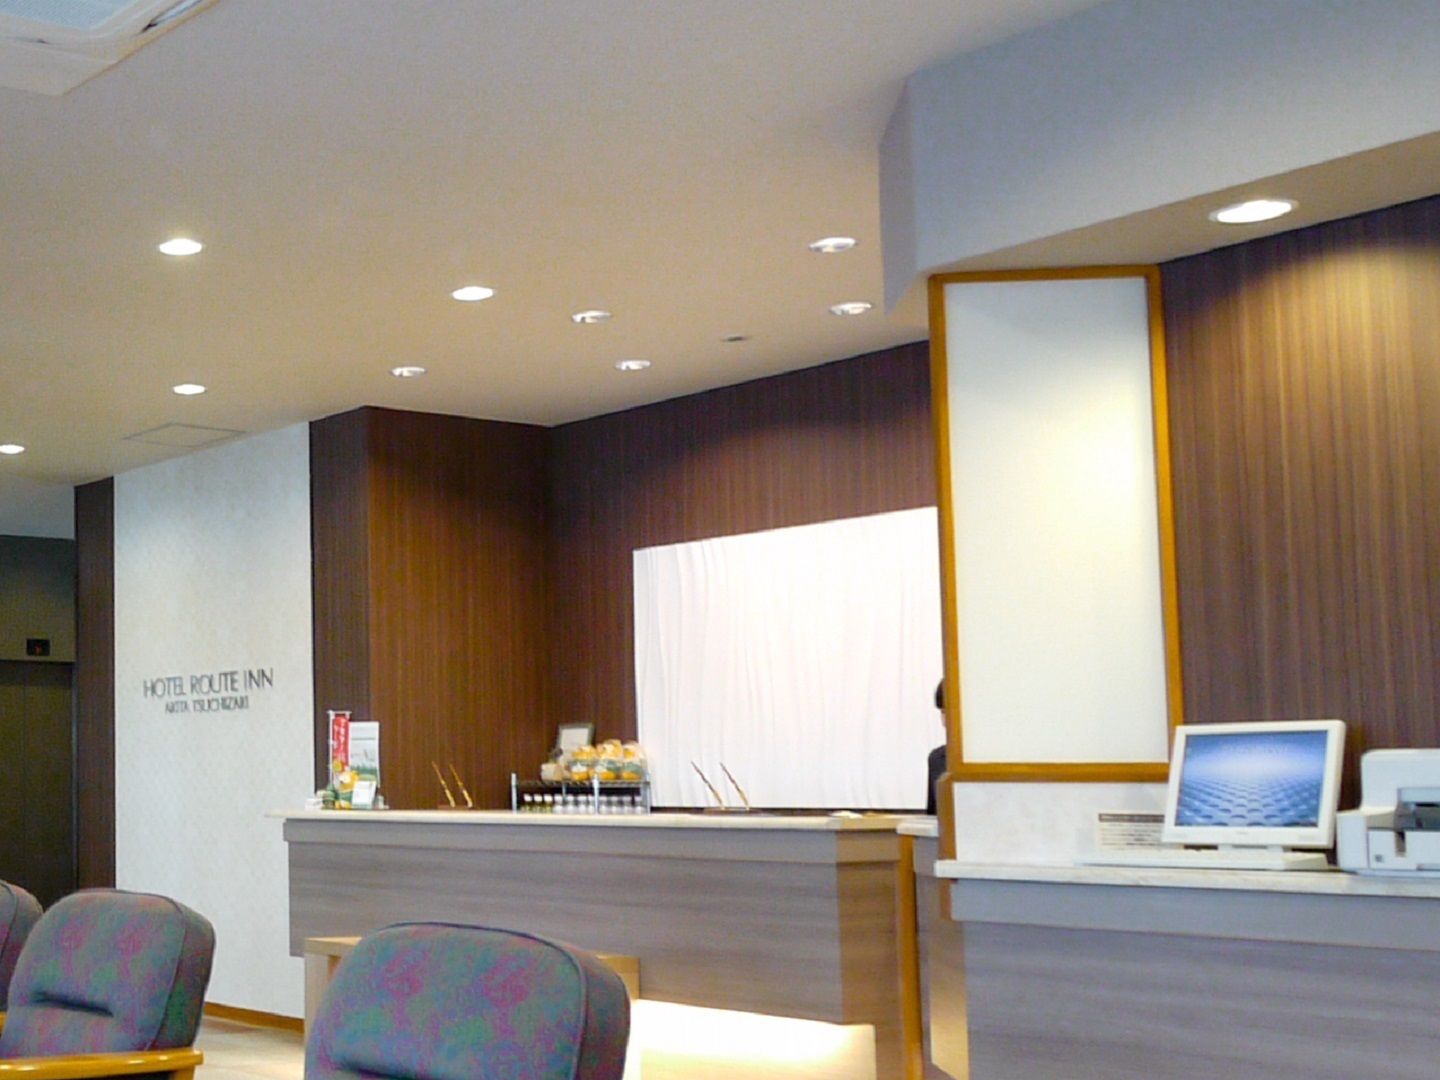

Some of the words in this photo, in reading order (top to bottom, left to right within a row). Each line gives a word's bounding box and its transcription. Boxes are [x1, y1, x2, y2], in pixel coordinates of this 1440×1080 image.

[143, 677, 186, 698] HOTEL
[190, 671, 239, 695] ROUTE
[244, 667, 273, 691] INN
